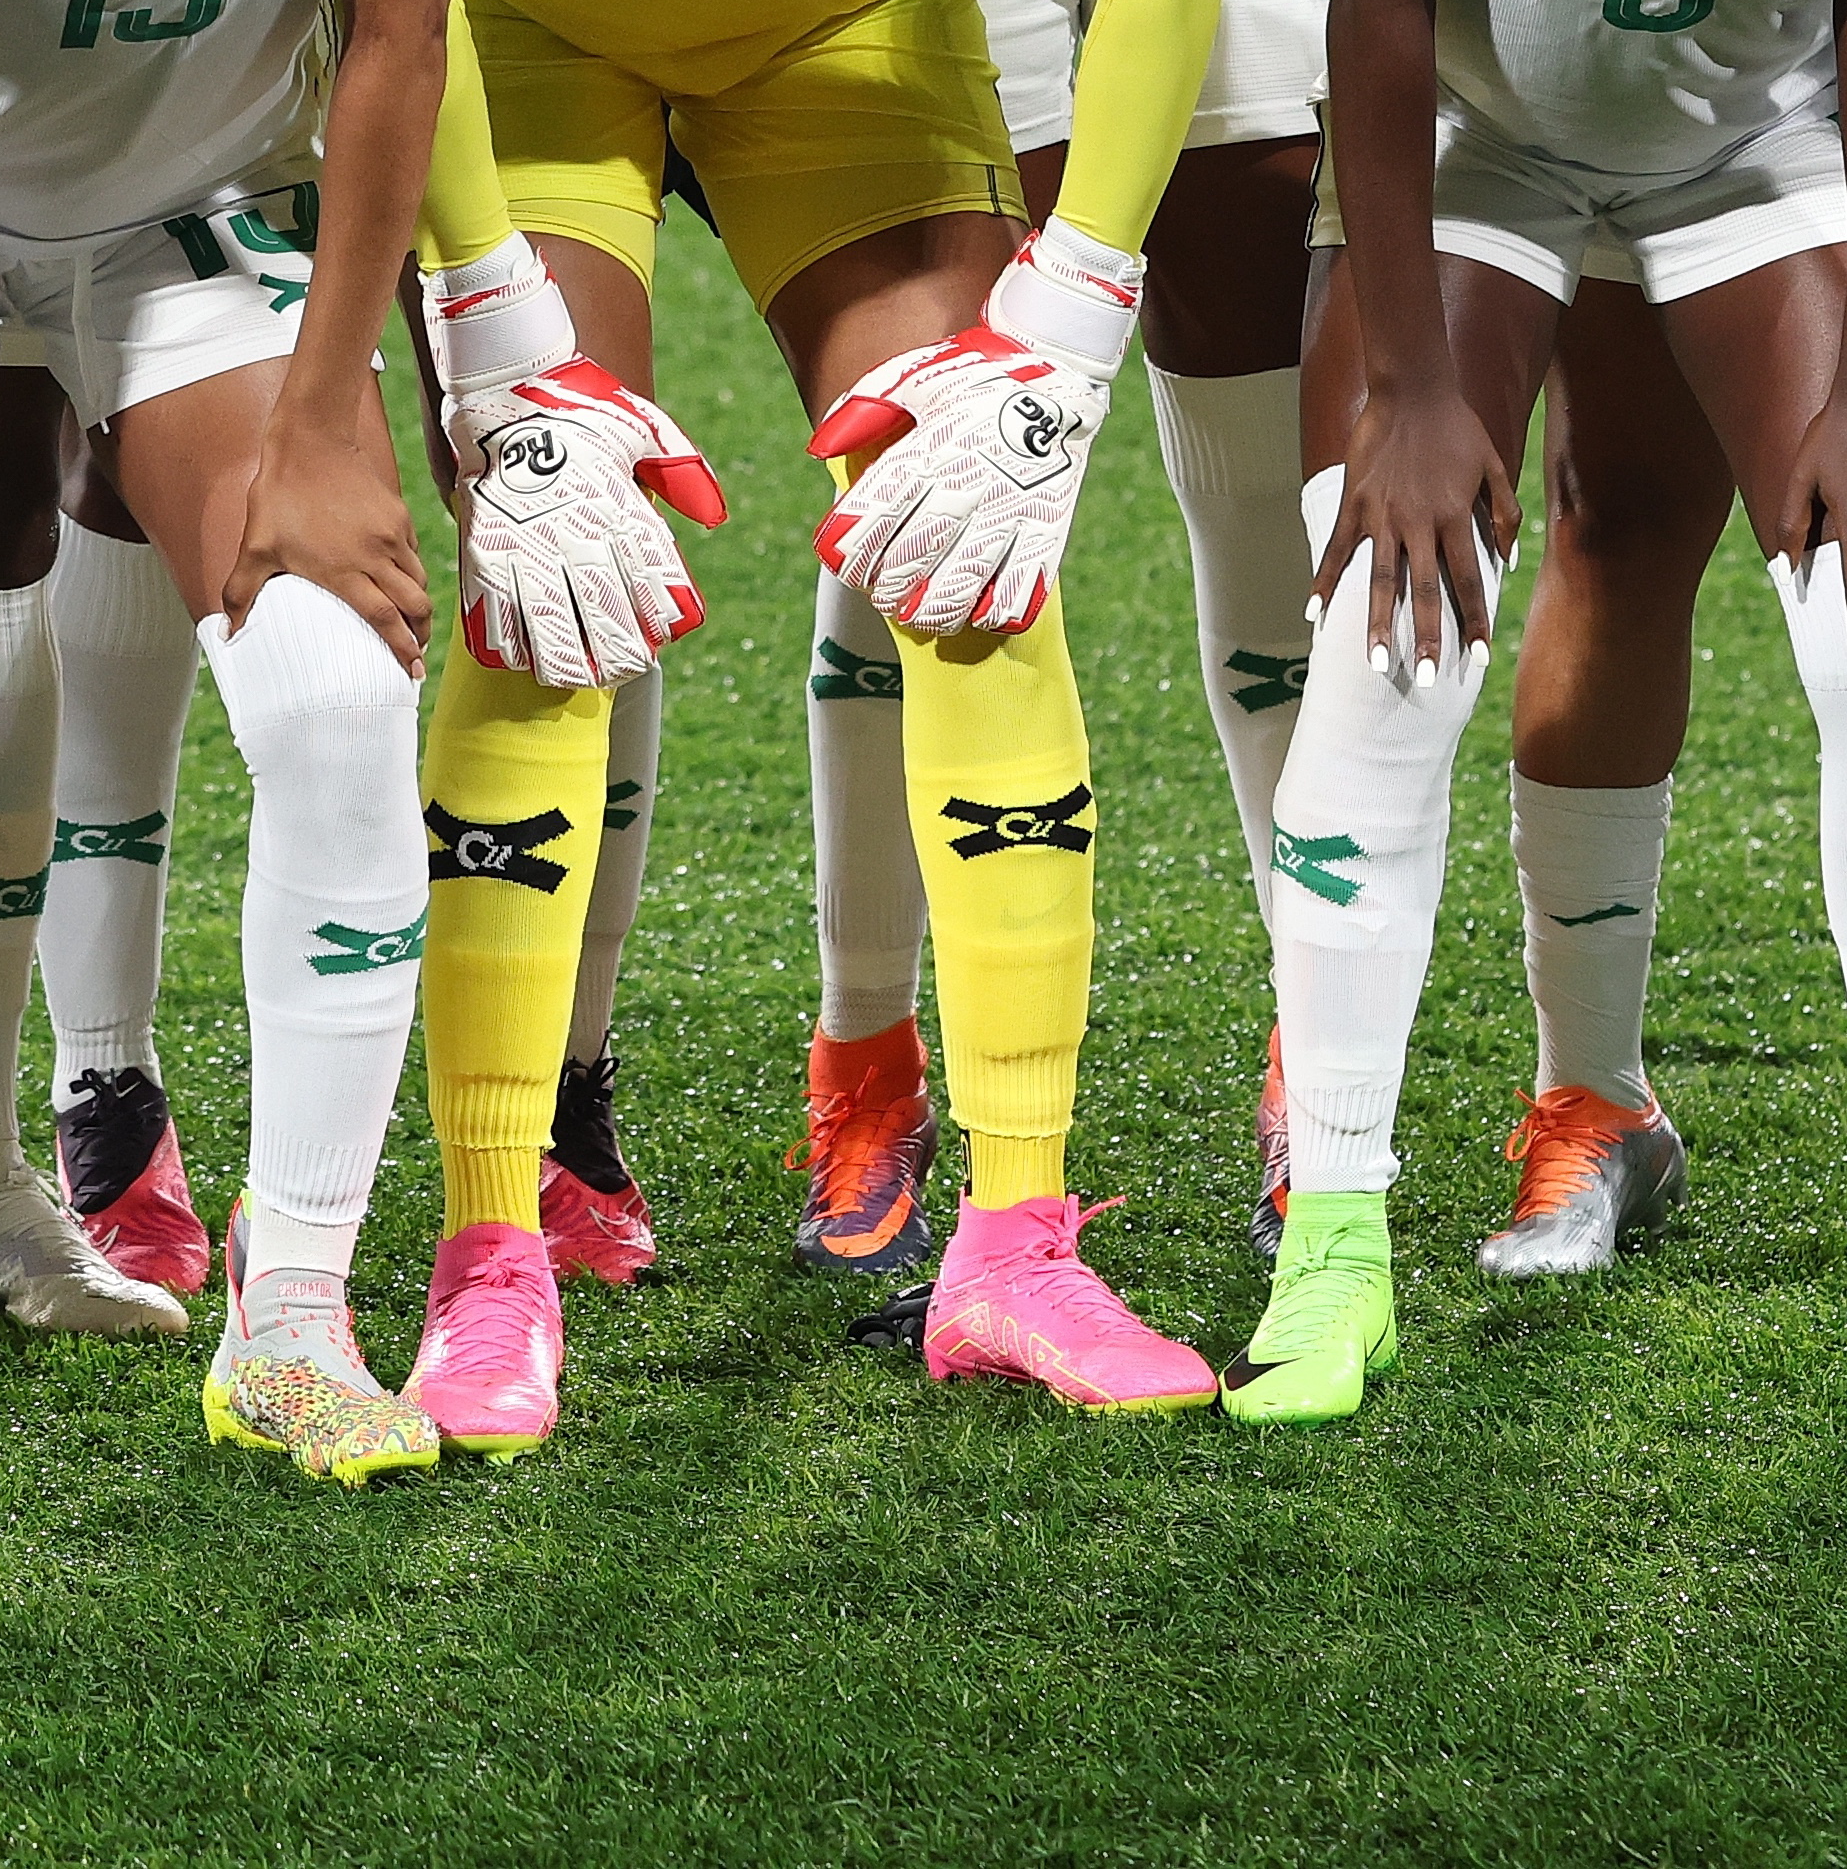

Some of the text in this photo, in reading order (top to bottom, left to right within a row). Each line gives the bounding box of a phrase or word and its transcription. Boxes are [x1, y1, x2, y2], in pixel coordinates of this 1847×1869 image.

[1013, 395, 1060, 458] RG
[503, 429, 567, 476] RG
[276, 1281, 333, 1299] PREDATOR
